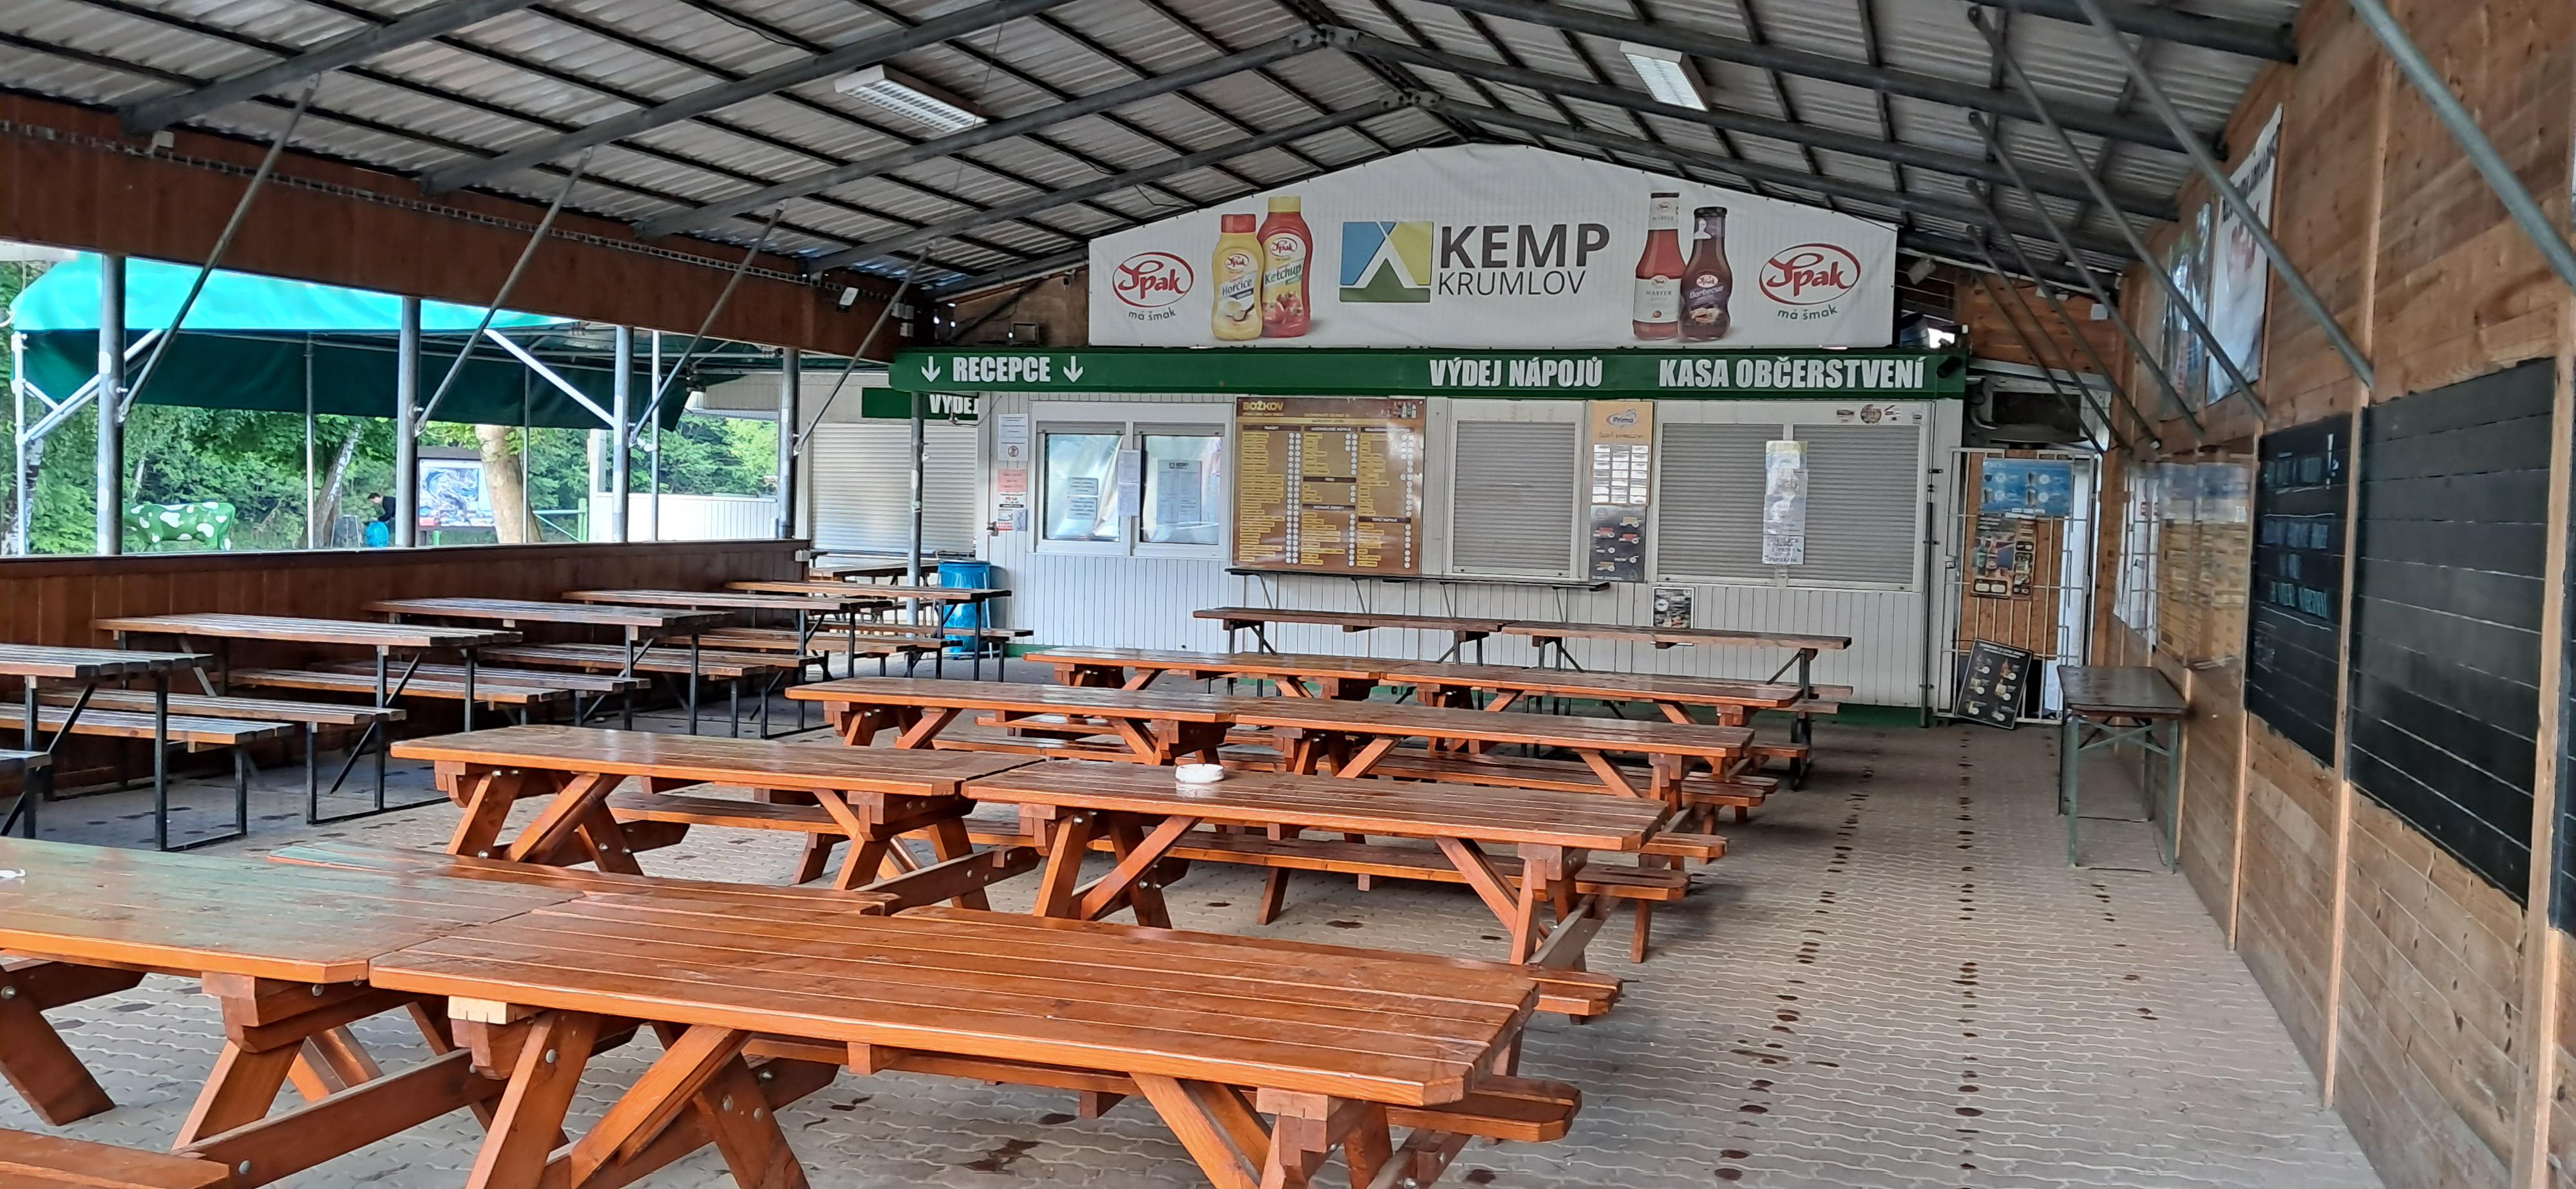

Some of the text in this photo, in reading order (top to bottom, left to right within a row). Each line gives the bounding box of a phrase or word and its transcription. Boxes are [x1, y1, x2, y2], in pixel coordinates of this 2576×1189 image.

[1440, 223, 1610, 268] KEMP
[1118, 260, 1186, 300] Spak
[1222, 277, 1253, 296] Hořčice
[1264, 263, 1302, 285] Ketchup
[1438, 270, 1586, 296] KRUMLOV
[1766, 252, 1853, 297] Spak
[1128, 306, 1177, 321] má šmak
[1777, 304, 1838, 321] má šmak
[952, 356, 1051, 382] RECEPCE
[1429, 356, 1603, 388] VÝDEJ NÁPOJŮ
[1658, 356, 1927, 388] KASA OBČERSTVENÍ
[1242, 400, 1284, 411] BOŽKOV
